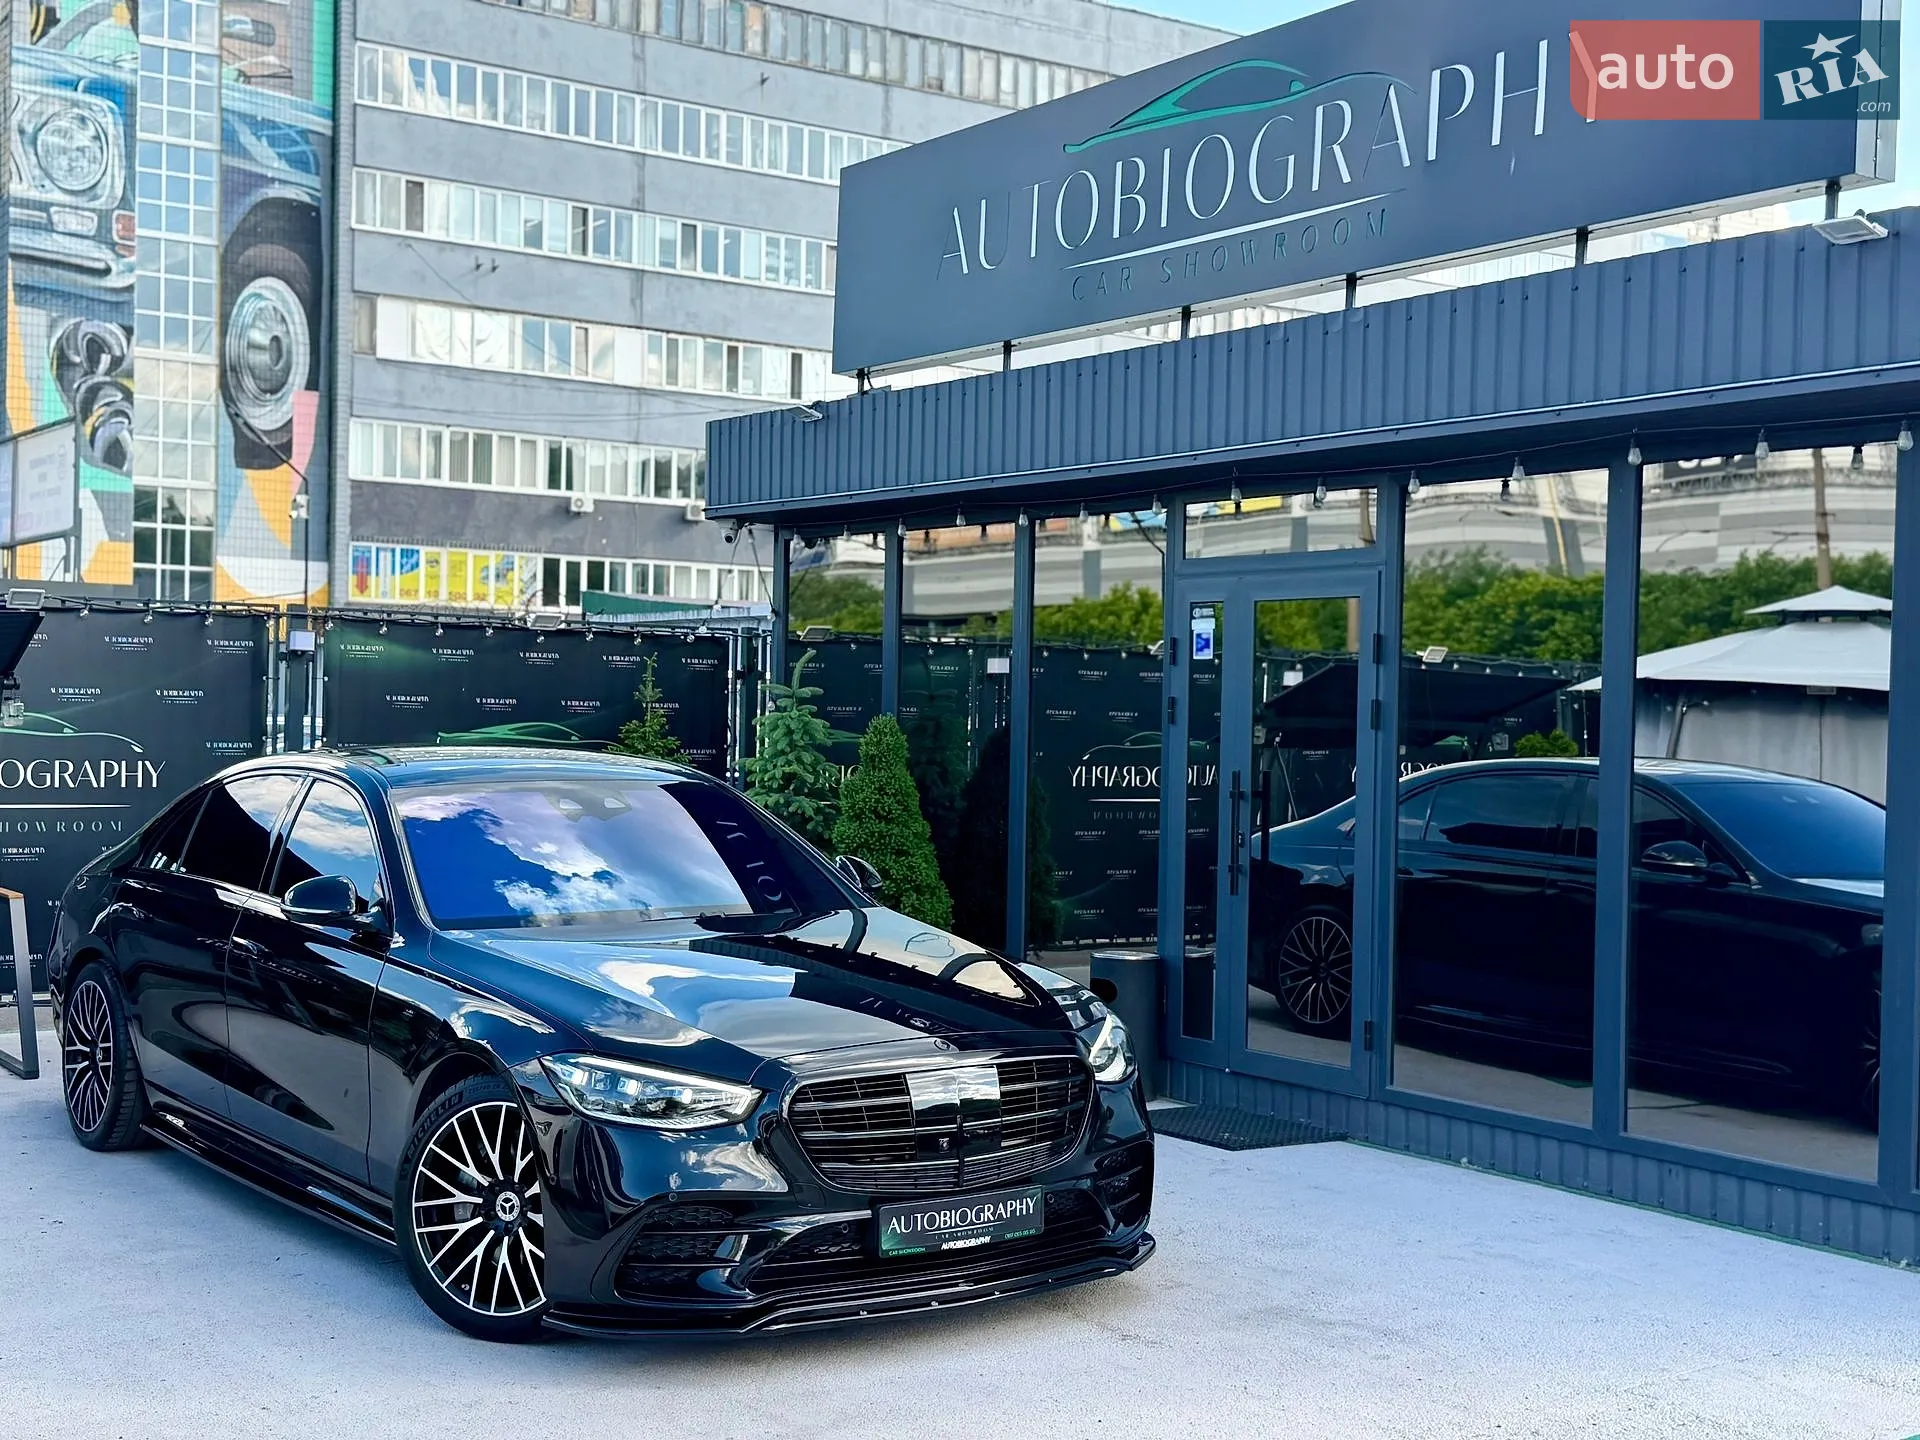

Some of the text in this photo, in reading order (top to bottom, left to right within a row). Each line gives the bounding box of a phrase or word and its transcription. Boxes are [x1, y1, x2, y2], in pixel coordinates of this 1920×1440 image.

[936, 31, 1600, 281] AUTOBIOGRAPHY
[1071, 207, 1388, 302] CAR SHOWROOM
[407, 1093, 460, 1160] MICHELIN
[887, 1197, 1037, 1235] AUTOBIOGRAPHY
[941, 1236, 991, 1250] AUTOBIOGRAPHY
